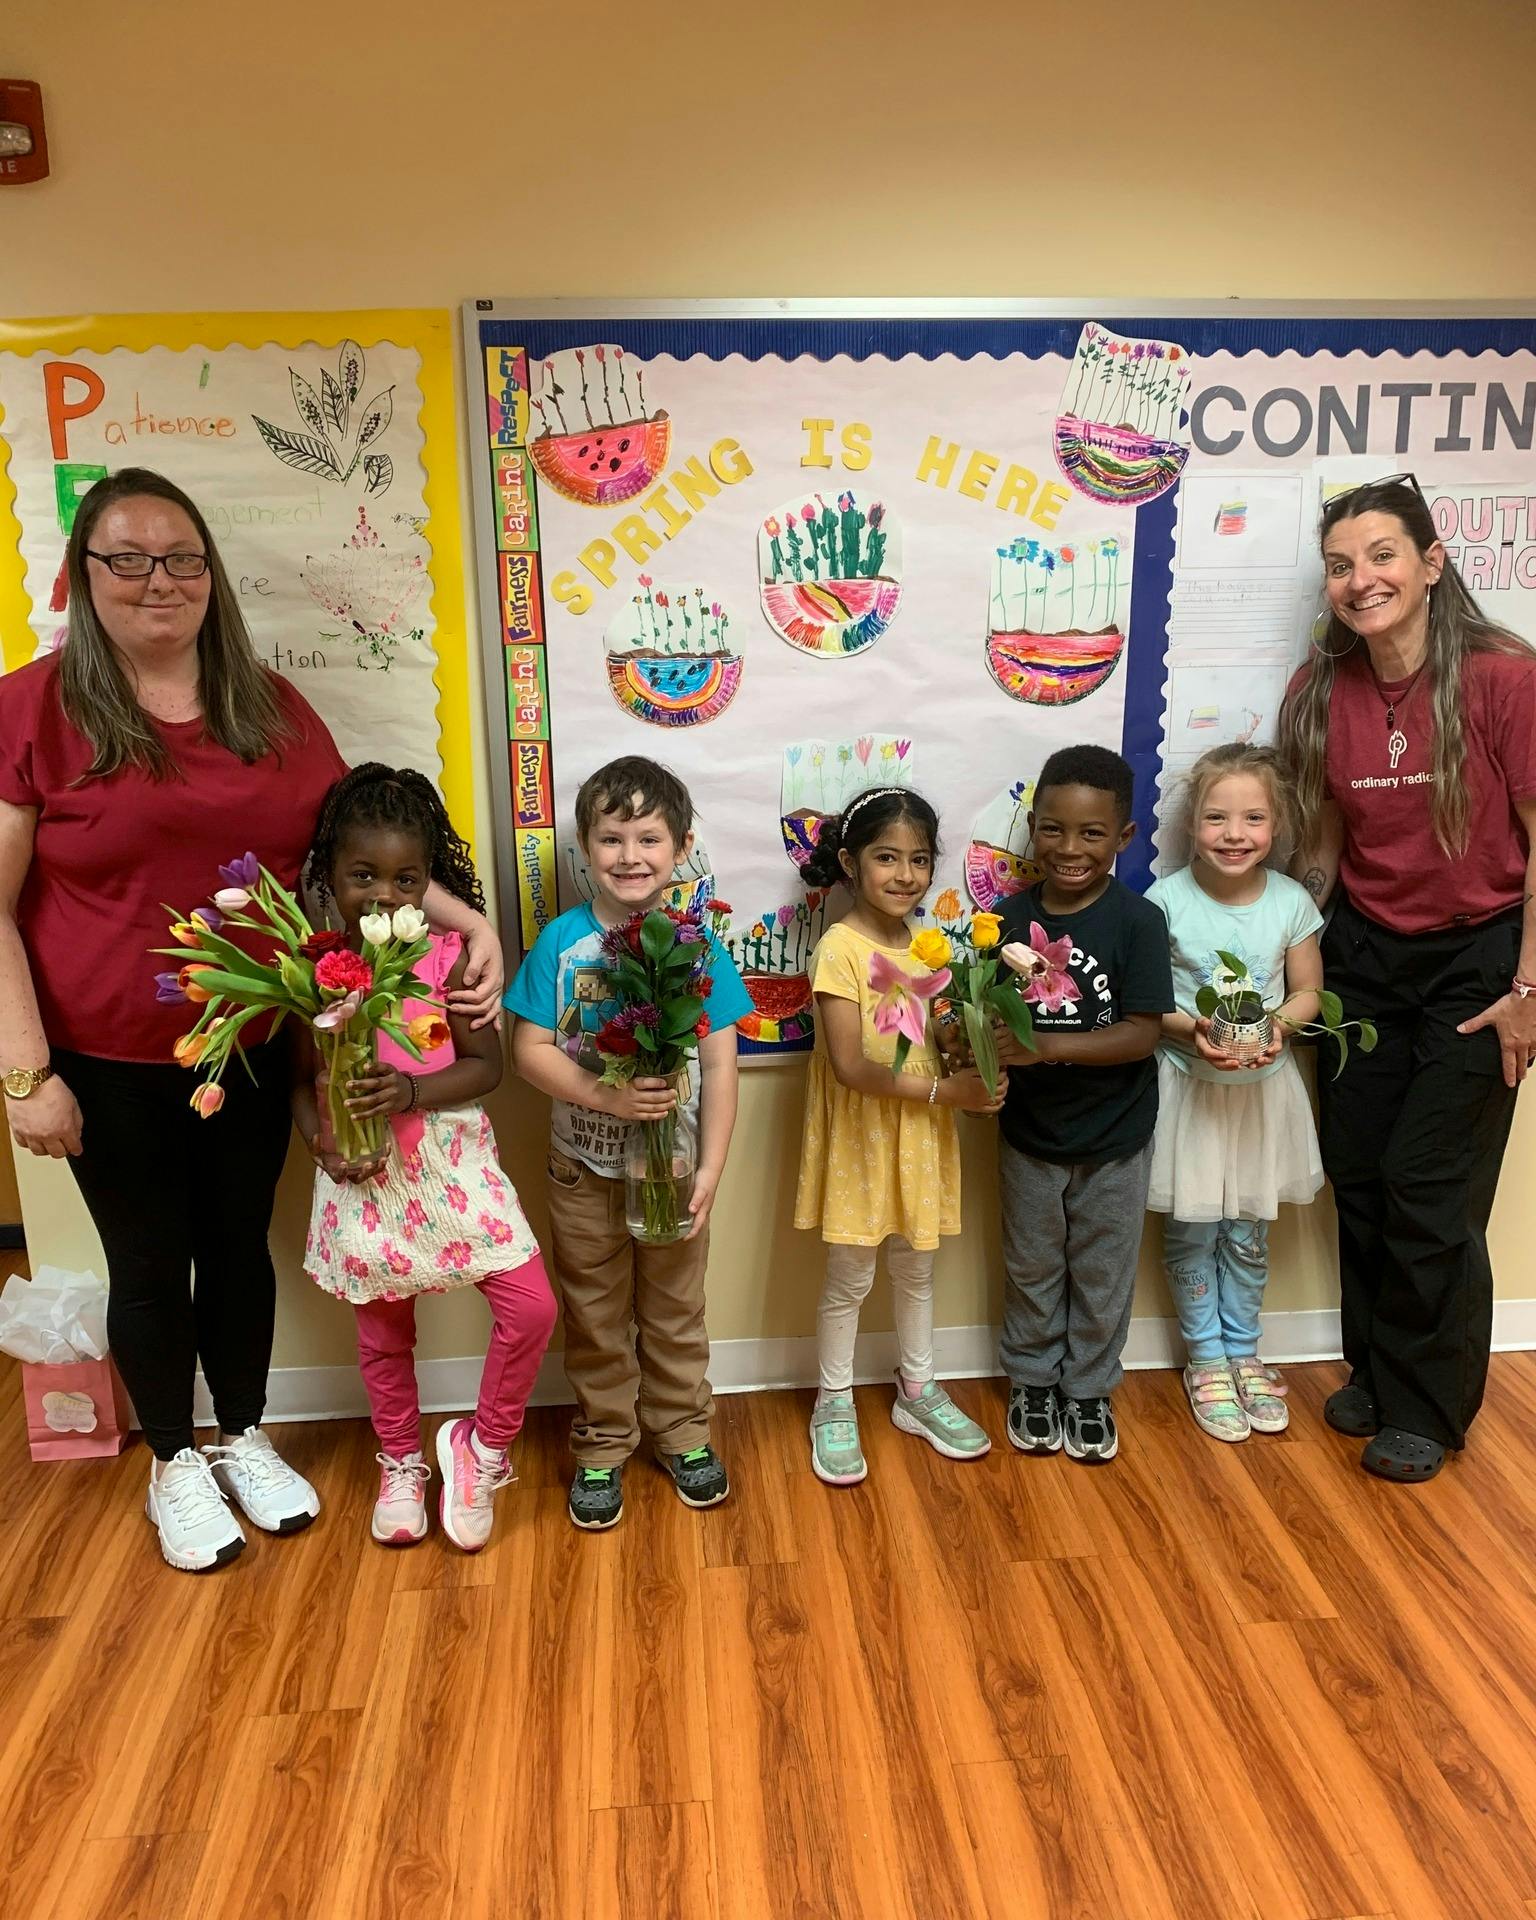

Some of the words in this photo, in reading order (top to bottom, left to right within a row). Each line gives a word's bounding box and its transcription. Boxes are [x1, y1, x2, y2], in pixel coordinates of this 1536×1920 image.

[1189, 382, 1536, 457] CONTIN
[550, 438, 755, 617] SPRING
[800, 418, 873, 471] IS
[915, 435, 1073, 532] HERE
[1429, 496, 1536, 542] OUT
[1351, 776, 1399, 789] ordinary
[1403, 771, 1434, 785] radic
[1093, 973, 1112, 1003] OF
